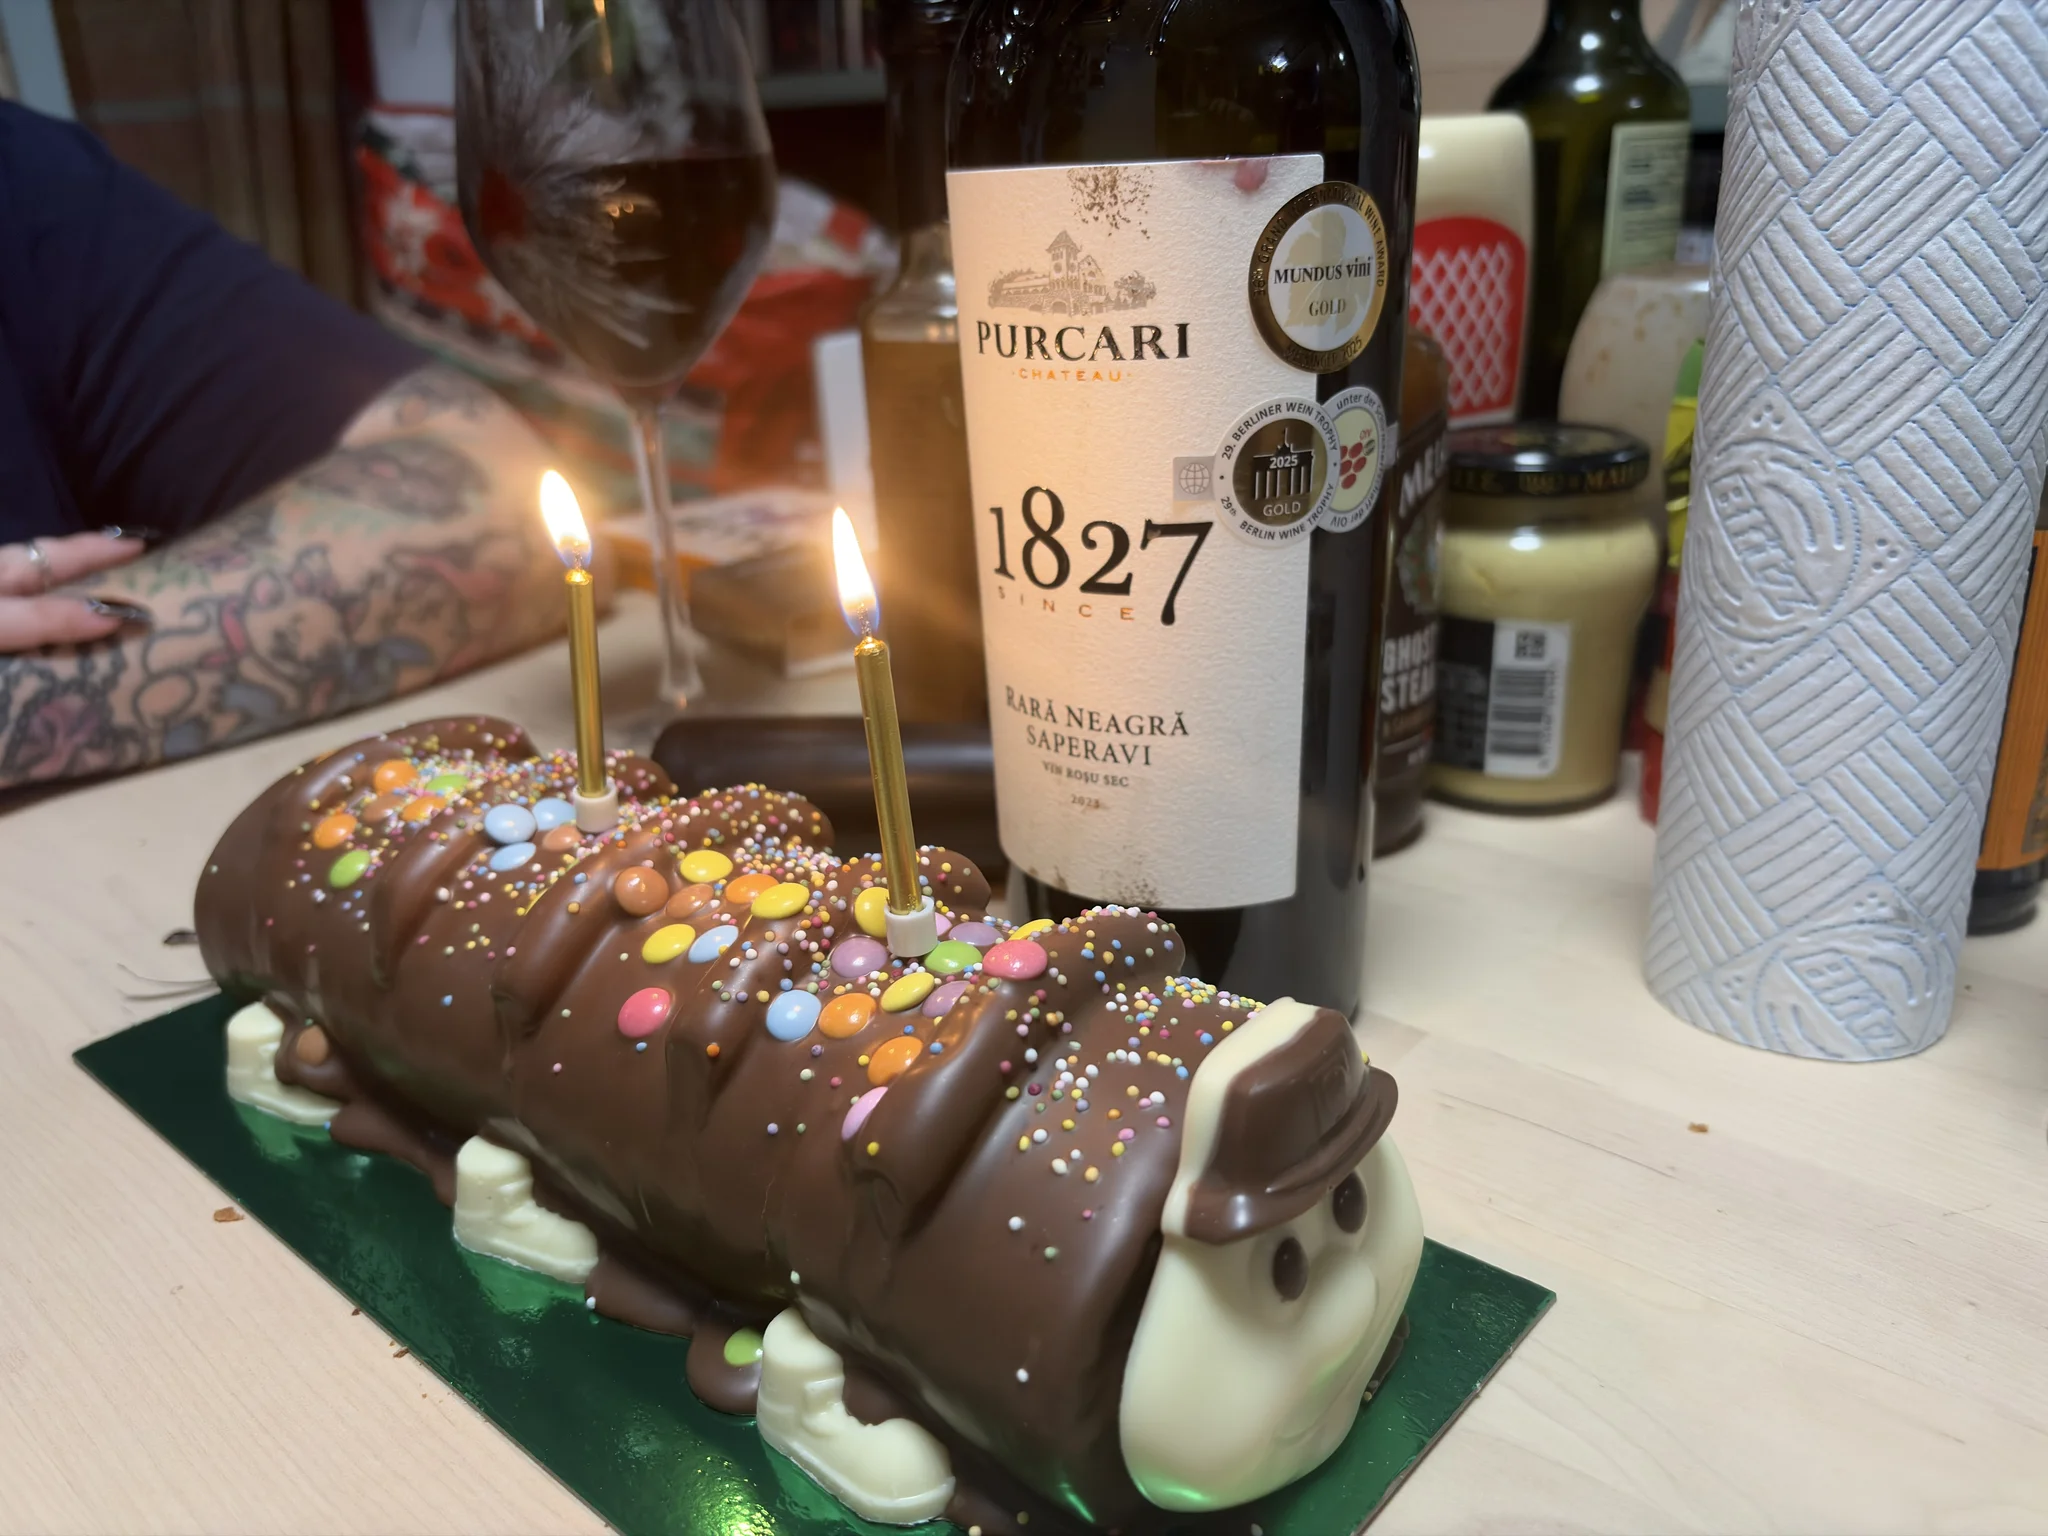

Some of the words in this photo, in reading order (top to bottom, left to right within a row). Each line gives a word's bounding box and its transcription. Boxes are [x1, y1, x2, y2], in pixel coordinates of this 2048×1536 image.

[1258, 217, 1288, 264] GRAND
[1364, 204, 1381, 236] WINE
[1375, 240, 1385, 287] AWARD
[1273, 264, 1342, 285] MUNDUS
[1346, 257, 1371, 277] vini
[1308, 298, 1347, 317] GOLD
[976, 320, 1190, 361] PURCARI
[1018, 367, 1122, 383] CHATEAU
[1336, 393, 1362, 410] unter
[1221, 443, 1237, 461] 29.
[1232, 403, 1282, 442] BERLINER
[1286, 402, 1313, 416] WEIN
[1314, 412, 1338, 451] TROPHY
[1269, 455, 1299, 469] 2025
[1220, 496, 1238, 517] 29th
[1239, 519, 1276, 541] BERLIN
[1279, 523, 1306, 540] WINE
[1307, 483, 1334, 526] TROPHY
[1262, 501, 1301, 517] GOLD
[989, 485, 1214, 626] 1827
[998, 585, 1135, 621] SINCE
[1065, 704, 1189, 737] NEAGRĂ
[1026, 724, 1152, 766] SAPERAVI
[1042, 760, 1063, 776] VIN
[1103, 774, 1130, 787] SEC
